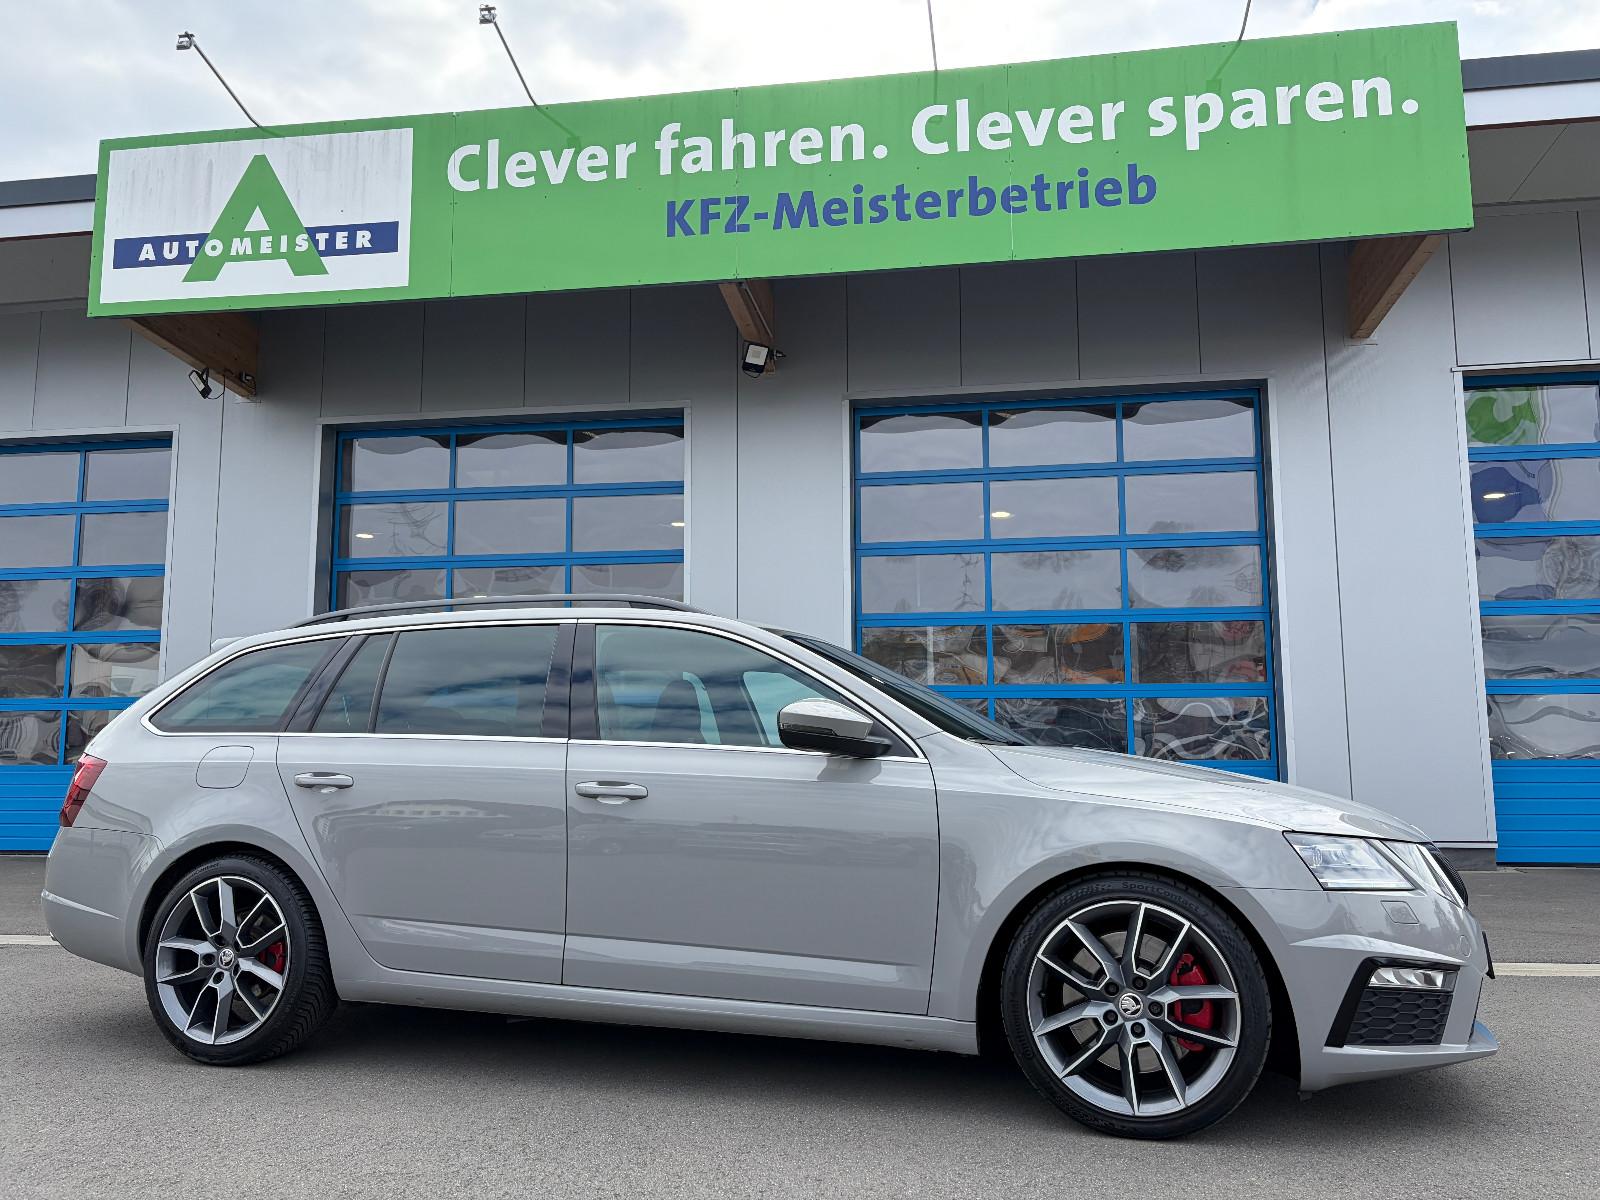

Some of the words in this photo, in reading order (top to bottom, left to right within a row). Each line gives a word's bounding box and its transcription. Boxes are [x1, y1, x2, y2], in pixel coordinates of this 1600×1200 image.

[447, 138, 637, 192] Clever
[653, 118, 888, 176] fahren.
[911, 98, 1126, 155] Clever
[1147, 76, 1419, 151] sparen.
[667, 163, 1157, 237] KFZ-Meisterbetrieb
[138, 230, 373, 262] AUTOMEISTER
